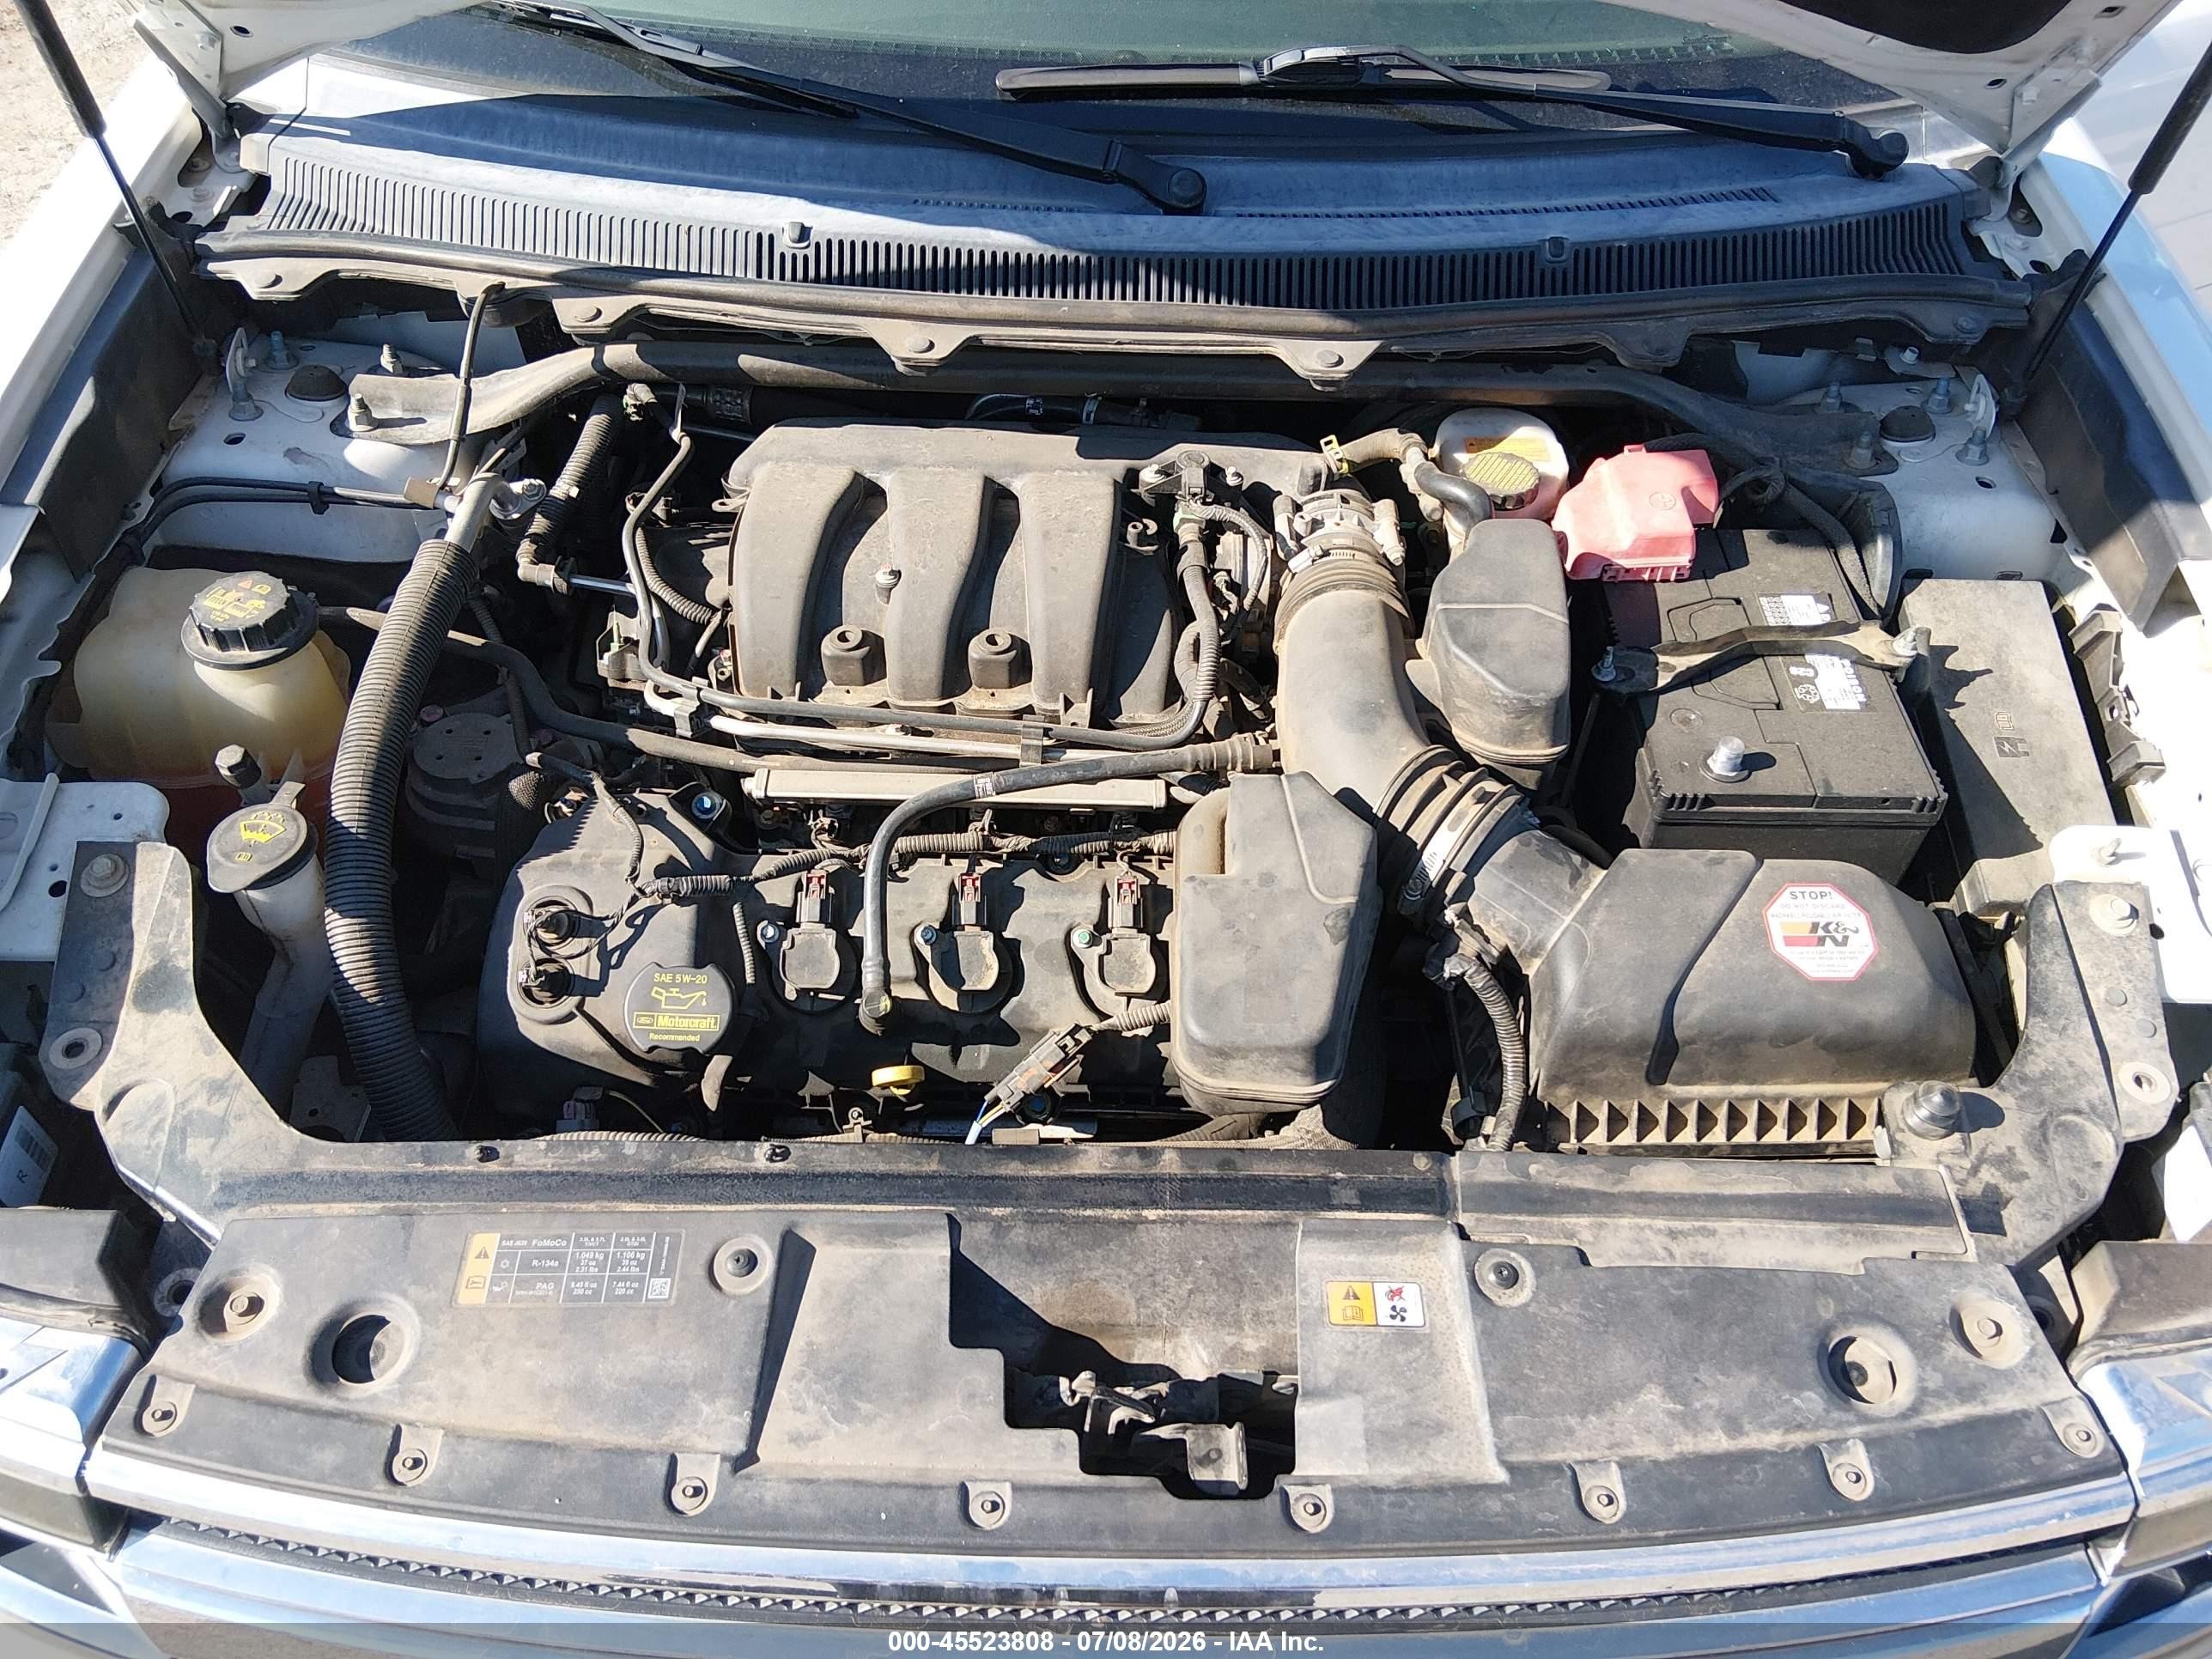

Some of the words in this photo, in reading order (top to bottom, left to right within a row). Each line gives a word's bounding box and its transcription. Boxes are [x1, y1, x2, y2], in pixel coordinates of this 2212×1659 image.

[1790, 890, 1833, 900] STOP!
[653, 973, 673, 982] SAE
[675, 974, 708, 984] 5W-20
[649, 1032, 701, 1042] Recommended
[532, 1238, 567, 1247] FoMoCo
[595, 1251, 605, 1261] kg
[636, 1251, 646, 1261] kg
[532, 1259, 559, 1267] R-134a
